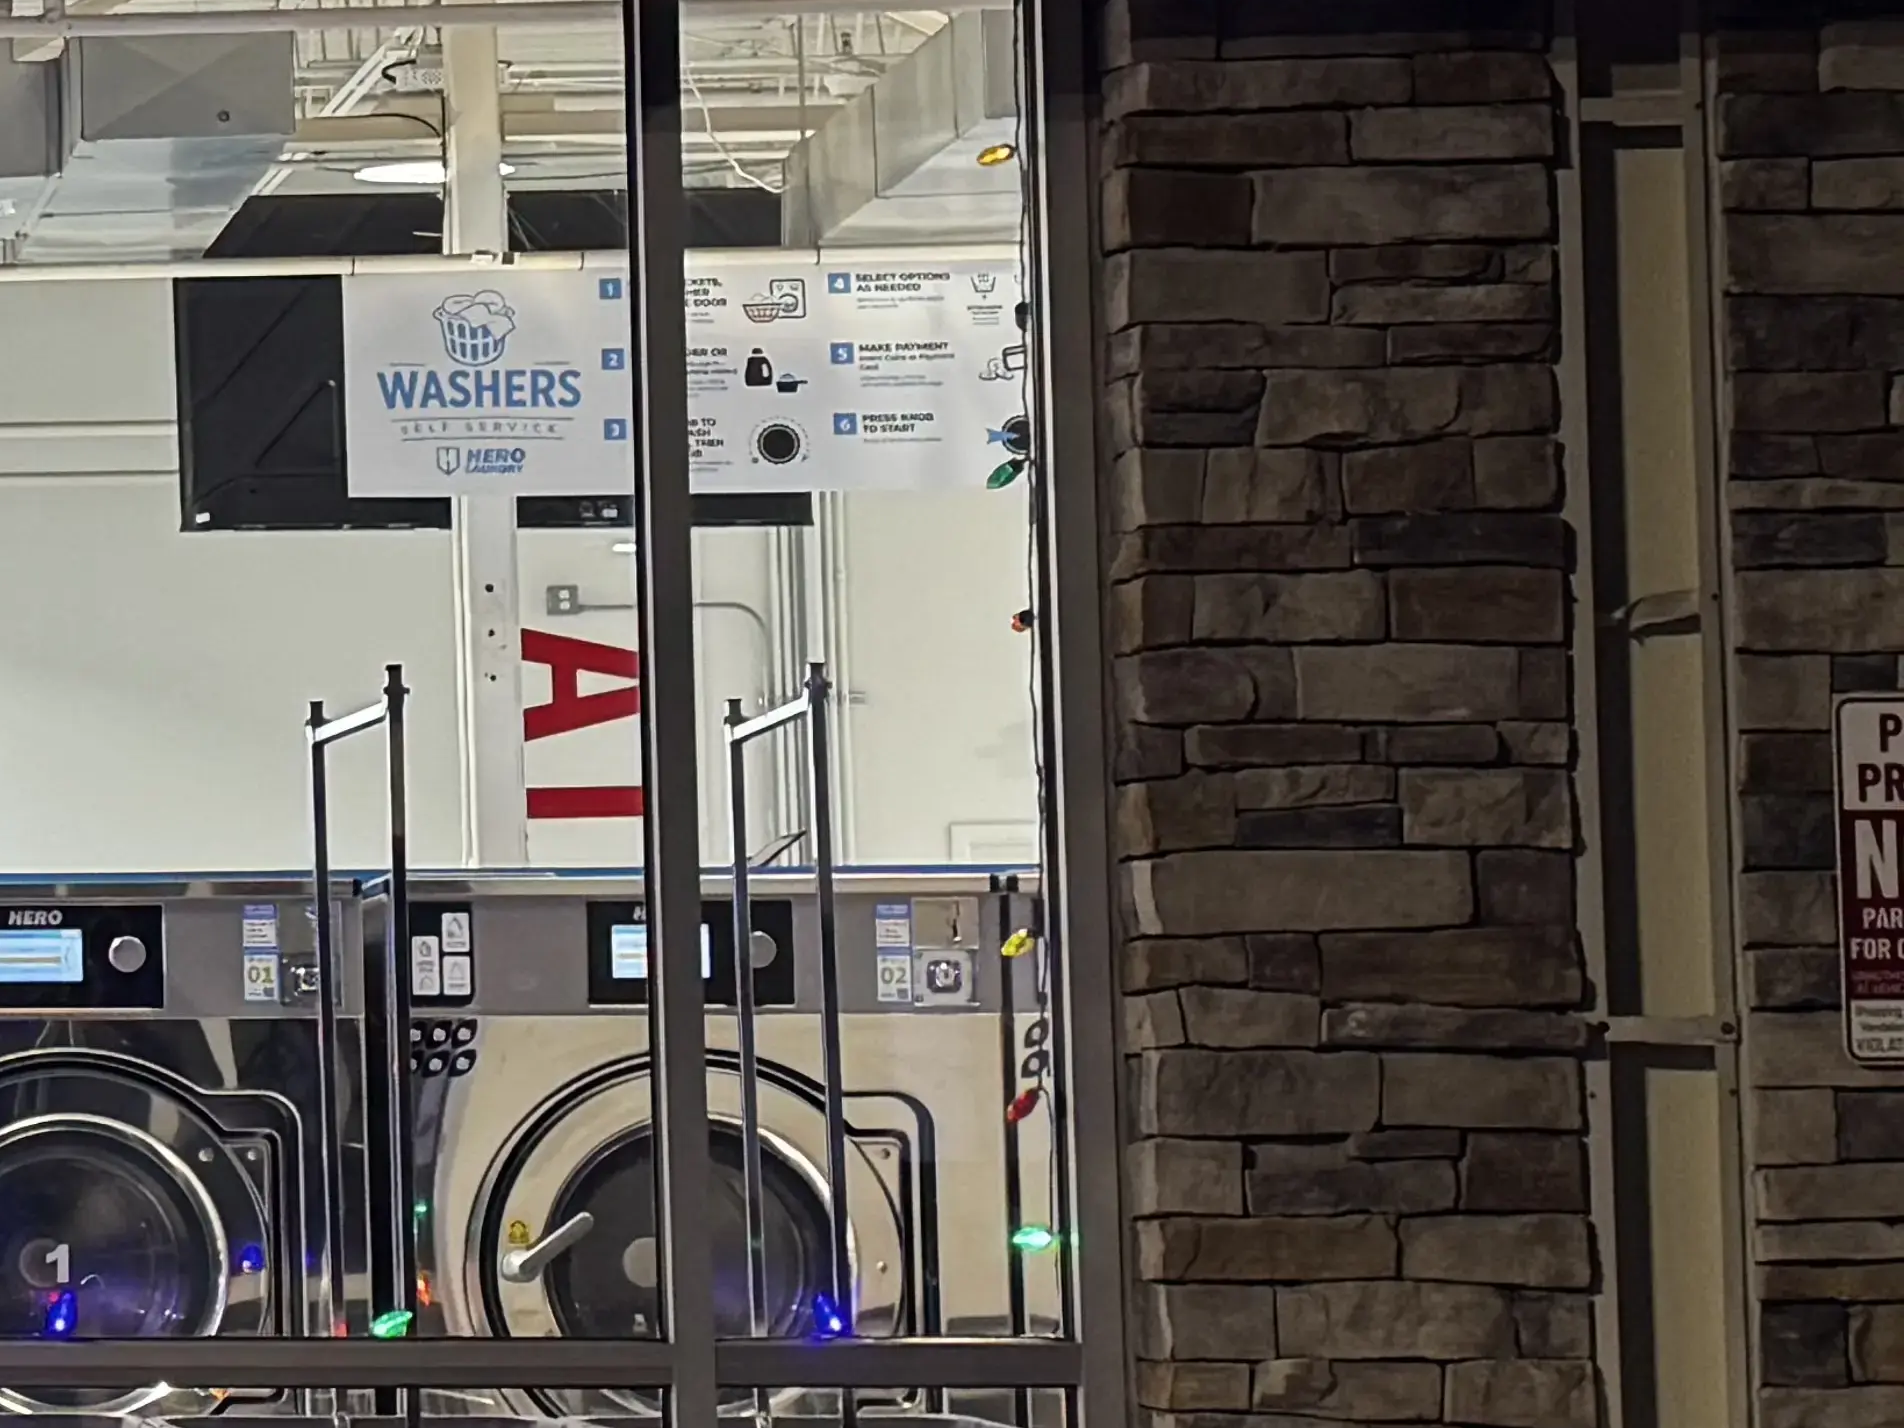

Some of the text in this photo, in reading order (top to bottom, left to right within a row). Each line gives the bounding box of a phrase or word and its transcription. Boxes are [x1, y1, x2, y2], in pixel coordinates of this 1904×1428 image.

[855, 272, 951, 282] SELECT OPTIONS
[856, 283, 921, 292] AS NEEDED
[858, 342, 949, 352] MAKE PAYMENT
[377, 369, 582, 410] WASHERS
[862, 413, 898, 422] PRESS
[465, 421, 559, 434] SERVICE
[863, 424, 915, 433] TO START
[466, 447, 526, 465] HERO
[8, 909, 63, 926] HERO
[1850, 938, 1891, 960] FOR
[248, 965, 274, 984] 01
[880, 966, 907, 985] 02
[45, 1243, 69, 1283] 1
